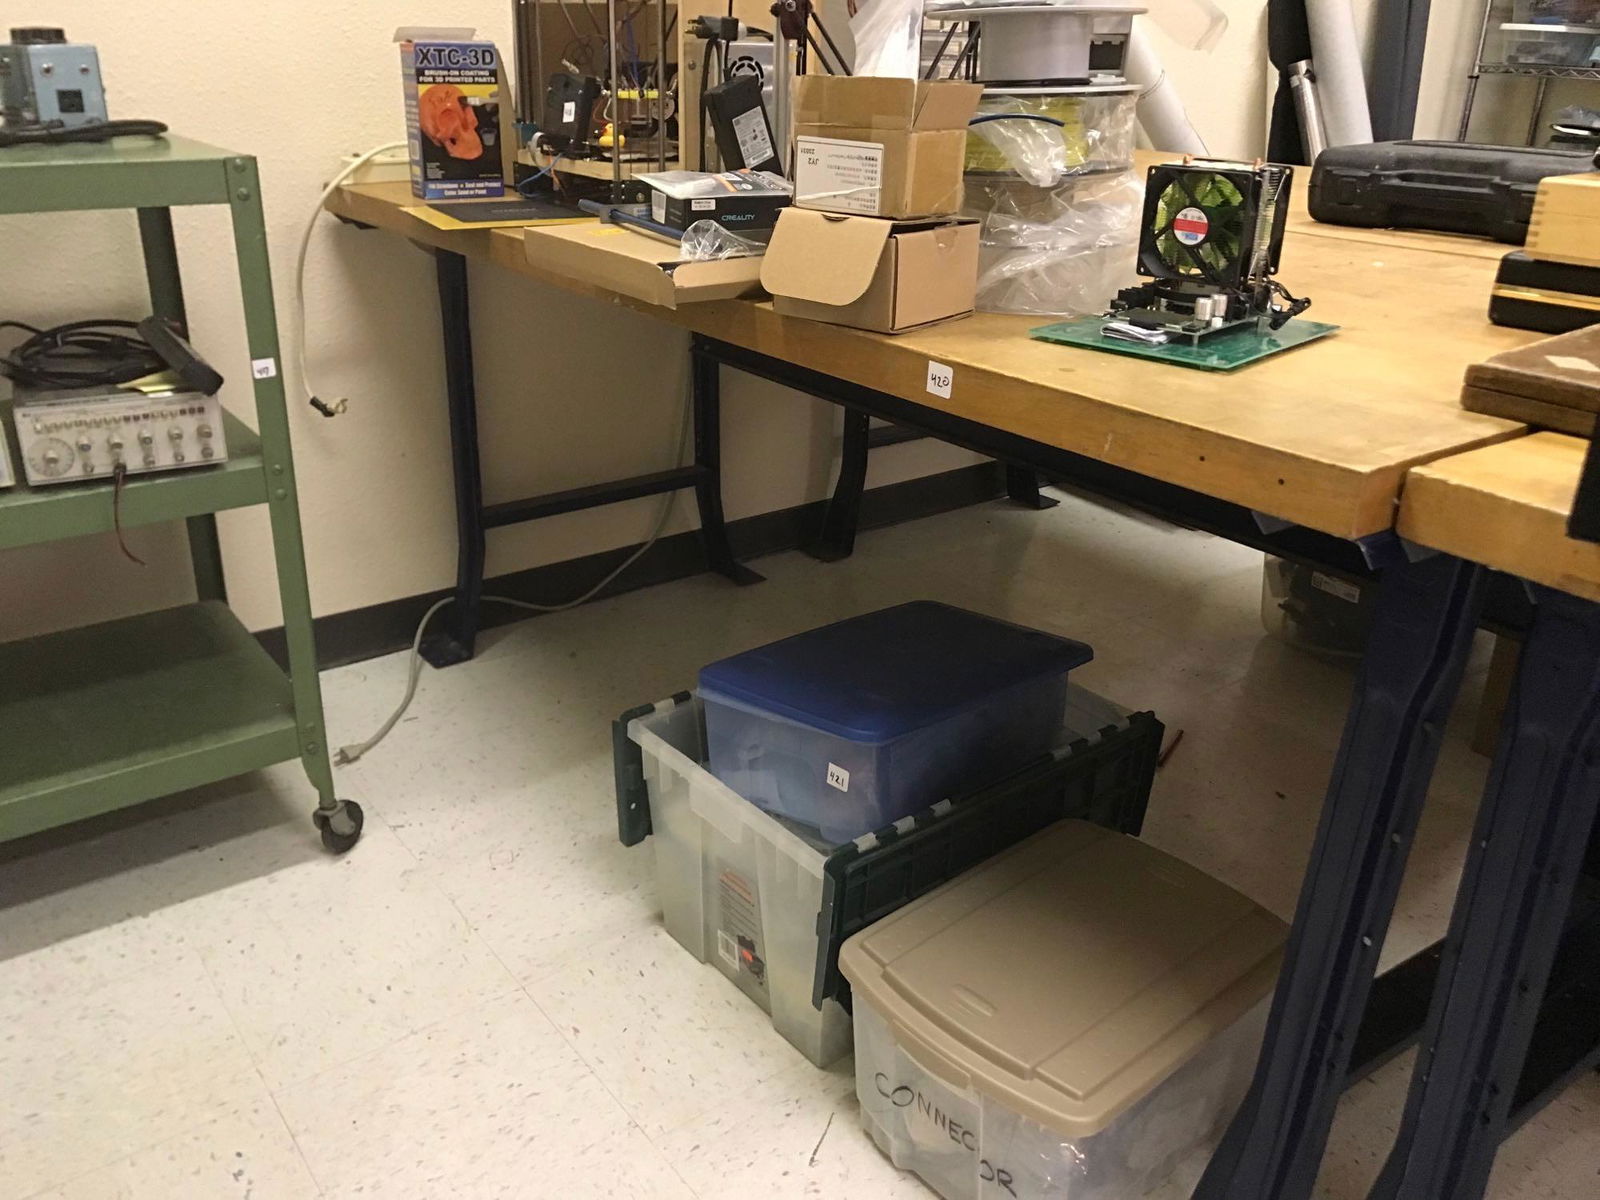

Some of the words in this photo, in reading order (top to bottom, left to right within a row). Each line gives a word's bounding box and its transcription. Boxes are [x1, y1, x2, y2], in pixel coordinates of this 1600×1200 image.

[417, 47, 495, 67] XTC-3D
[931, 373, 950, 388] 420
[829, 771, 845, 787] 421
[874, 1072, 1017, 1198] CONNECOR
